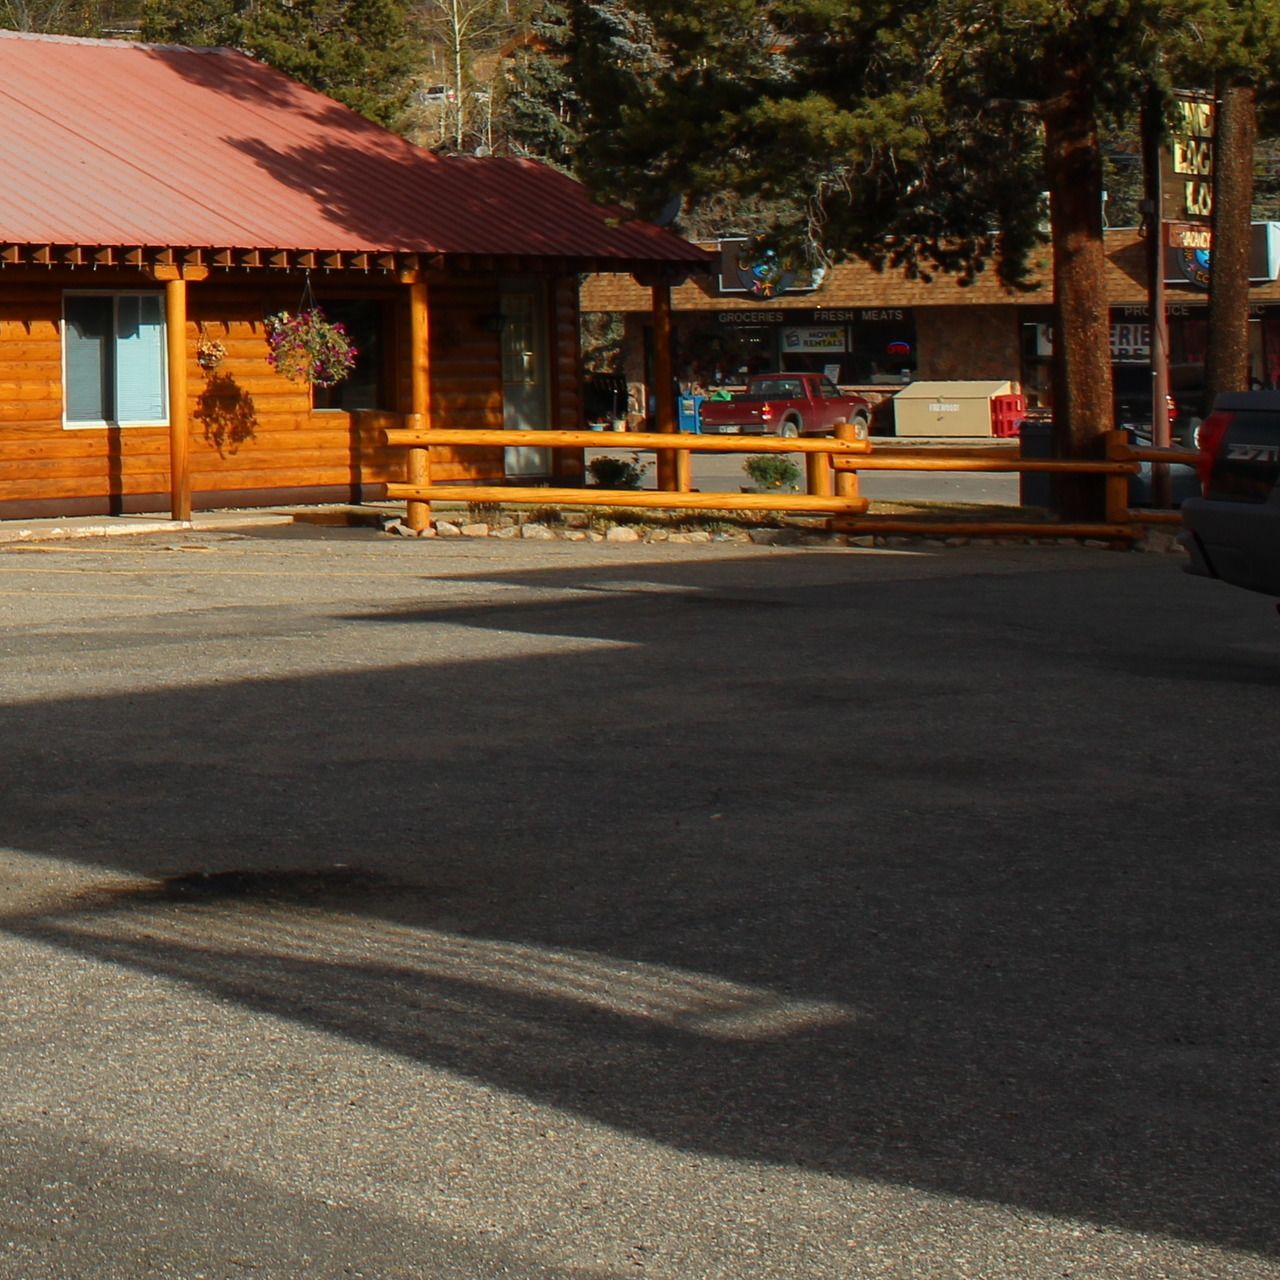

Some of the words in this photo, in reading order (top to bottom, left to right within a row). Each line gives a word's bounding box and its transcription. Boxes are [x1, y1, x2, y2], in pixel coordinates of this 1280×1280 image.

[718, 311, 784, 323] GROCERIES
[813, 310, 854, 321] FRESH
[861, 309, 904, 321] MEATS
[808, 330, 838, 338] MOVIE
[803, 339, 845, 347] RENTALS
